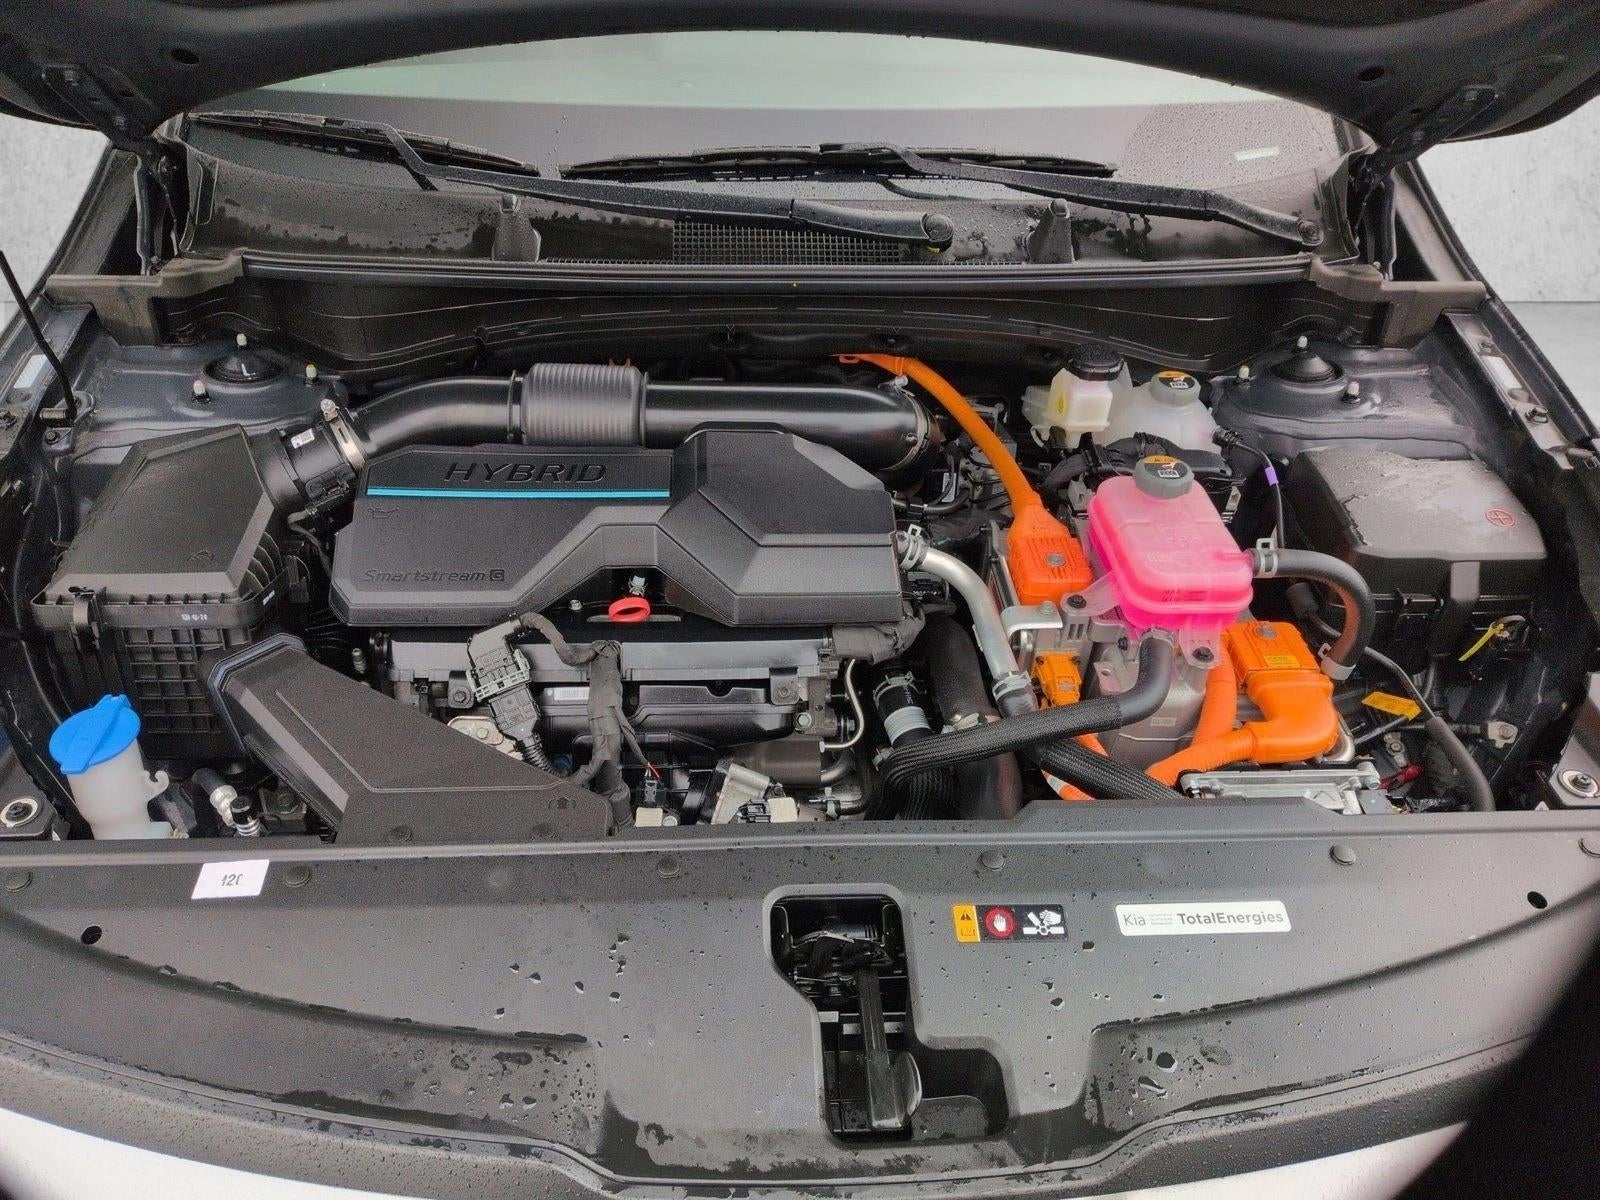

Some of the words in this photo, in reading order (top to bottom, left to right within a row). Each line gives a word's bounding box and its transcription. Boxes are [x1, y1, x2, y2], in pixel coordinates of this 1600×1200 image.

[444, 462, 608, 483] HYBRID
[364, 569, 485, 582] Smartstream
[1123, 914, 1147, 926] Kia
[1177, 911, 1284, 926] TotalEnergies
